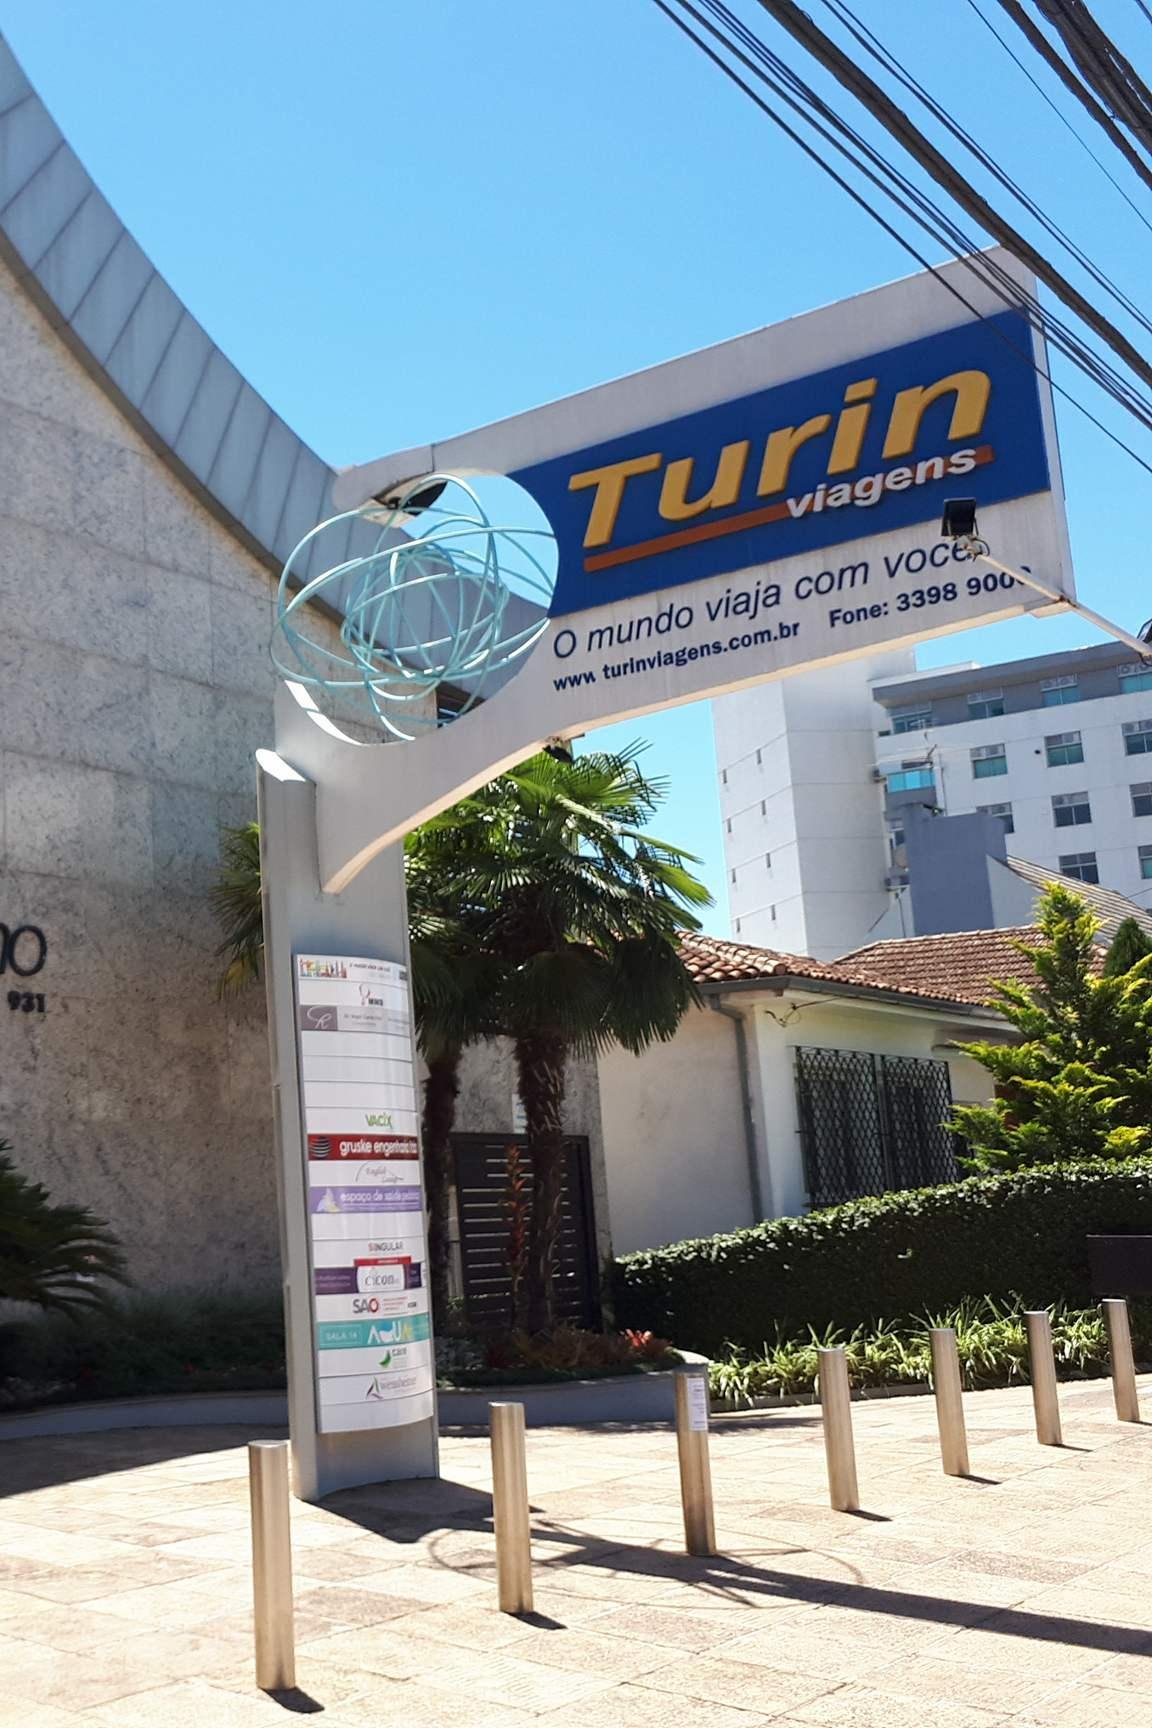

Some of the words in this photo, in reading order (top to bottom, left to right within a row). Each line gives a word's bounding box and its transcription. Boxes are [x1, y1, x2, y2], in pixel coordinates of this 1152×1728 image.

[568, 369, 991, 549] Turin
[786, 447, 977, 519] viagens
[553, 629, 577, 659] O
[587, 603, 693, 653] mundo
[704, 581, 782, 623] viaja
[795, 559, 869, 600] com
[829, 600, 889, 629] Fone:
[896, 583, 958, 612] 3398
[602, 621, 800, 680] turinviagens.com.br
[6, 990, 45, 1012] 931
[339, 1139, 373, 1156] gruske
